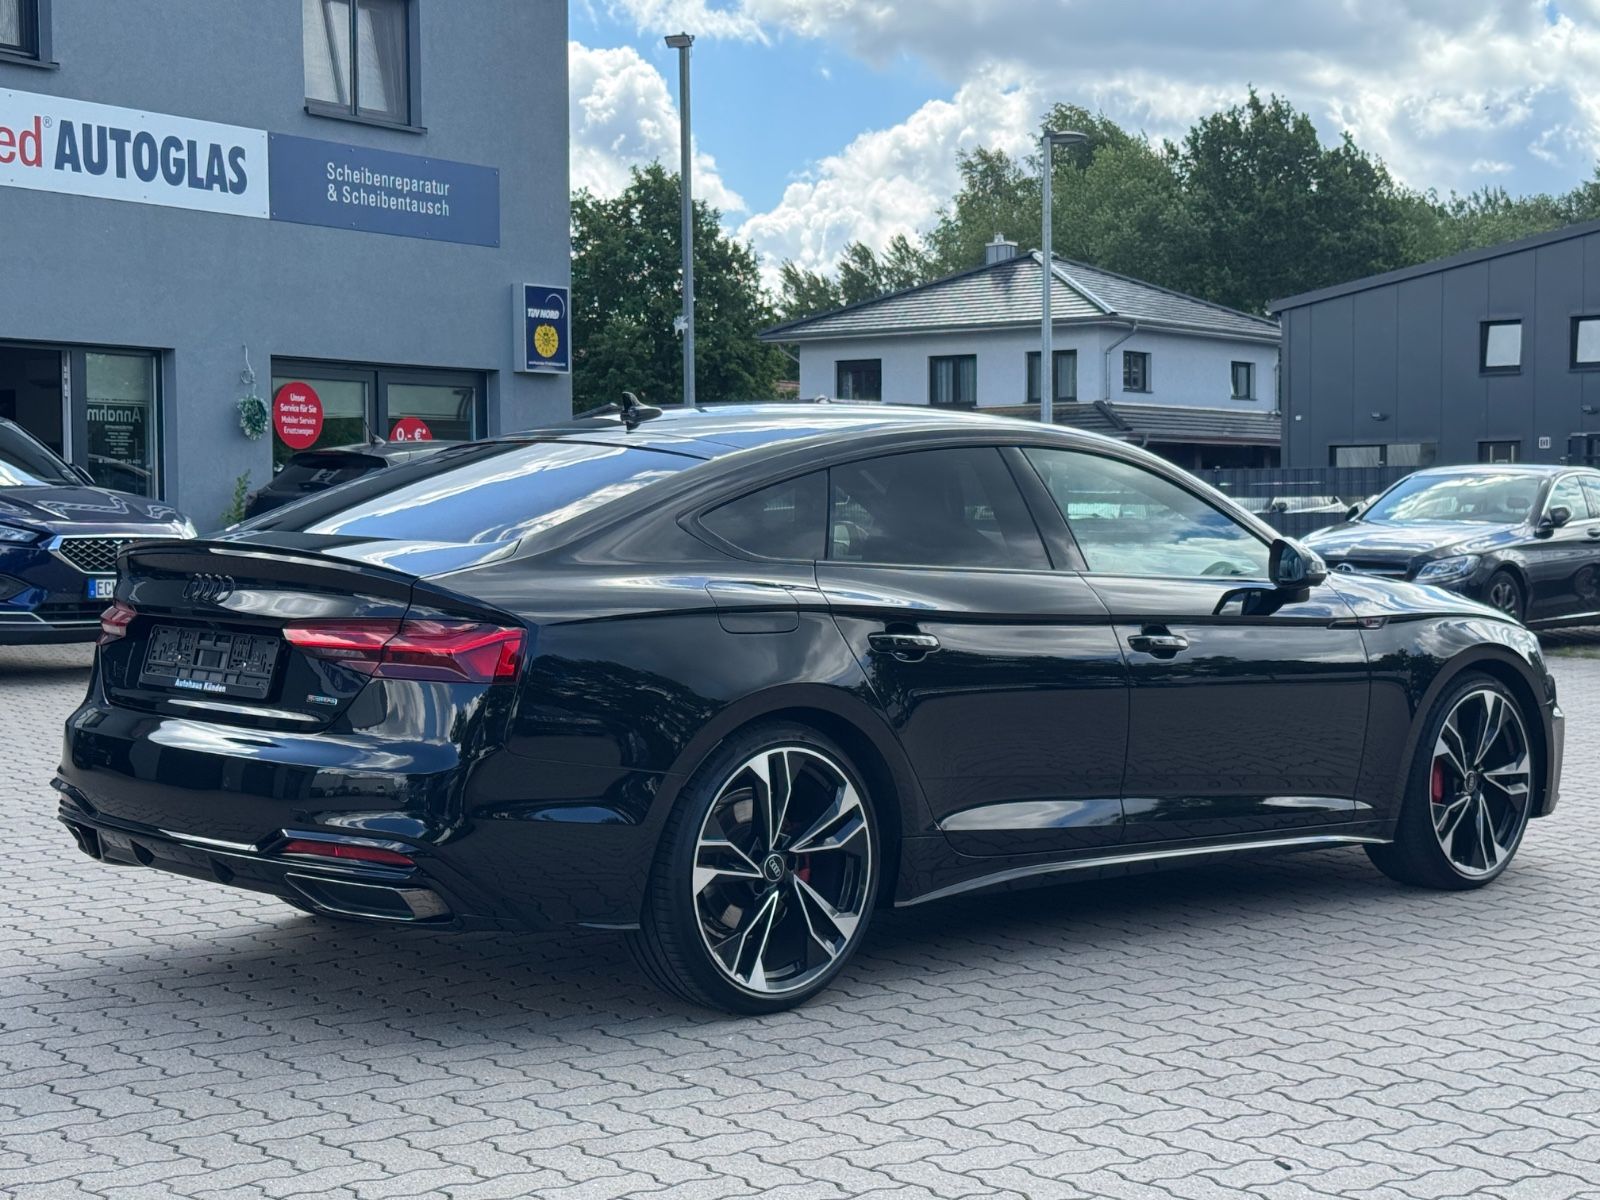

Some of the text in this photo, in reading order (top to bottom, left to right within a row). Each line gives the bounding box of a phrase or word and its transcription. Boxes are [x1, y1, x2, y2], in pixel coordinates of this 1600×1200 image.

[54, 119, 248, 195] AUTOGLAS
[327, 162, 450, 196] Scheibenreparatur
[327, 183, 450, 216] & Scheibentausch
[540, 309, 560, 320] NORD
[290, 392, 306, 402] Unser
[280, 403, 317, 413] Service für Sie
[299, 416, 316, 425] Service
[175, 678, 203, 690] Autohaus
